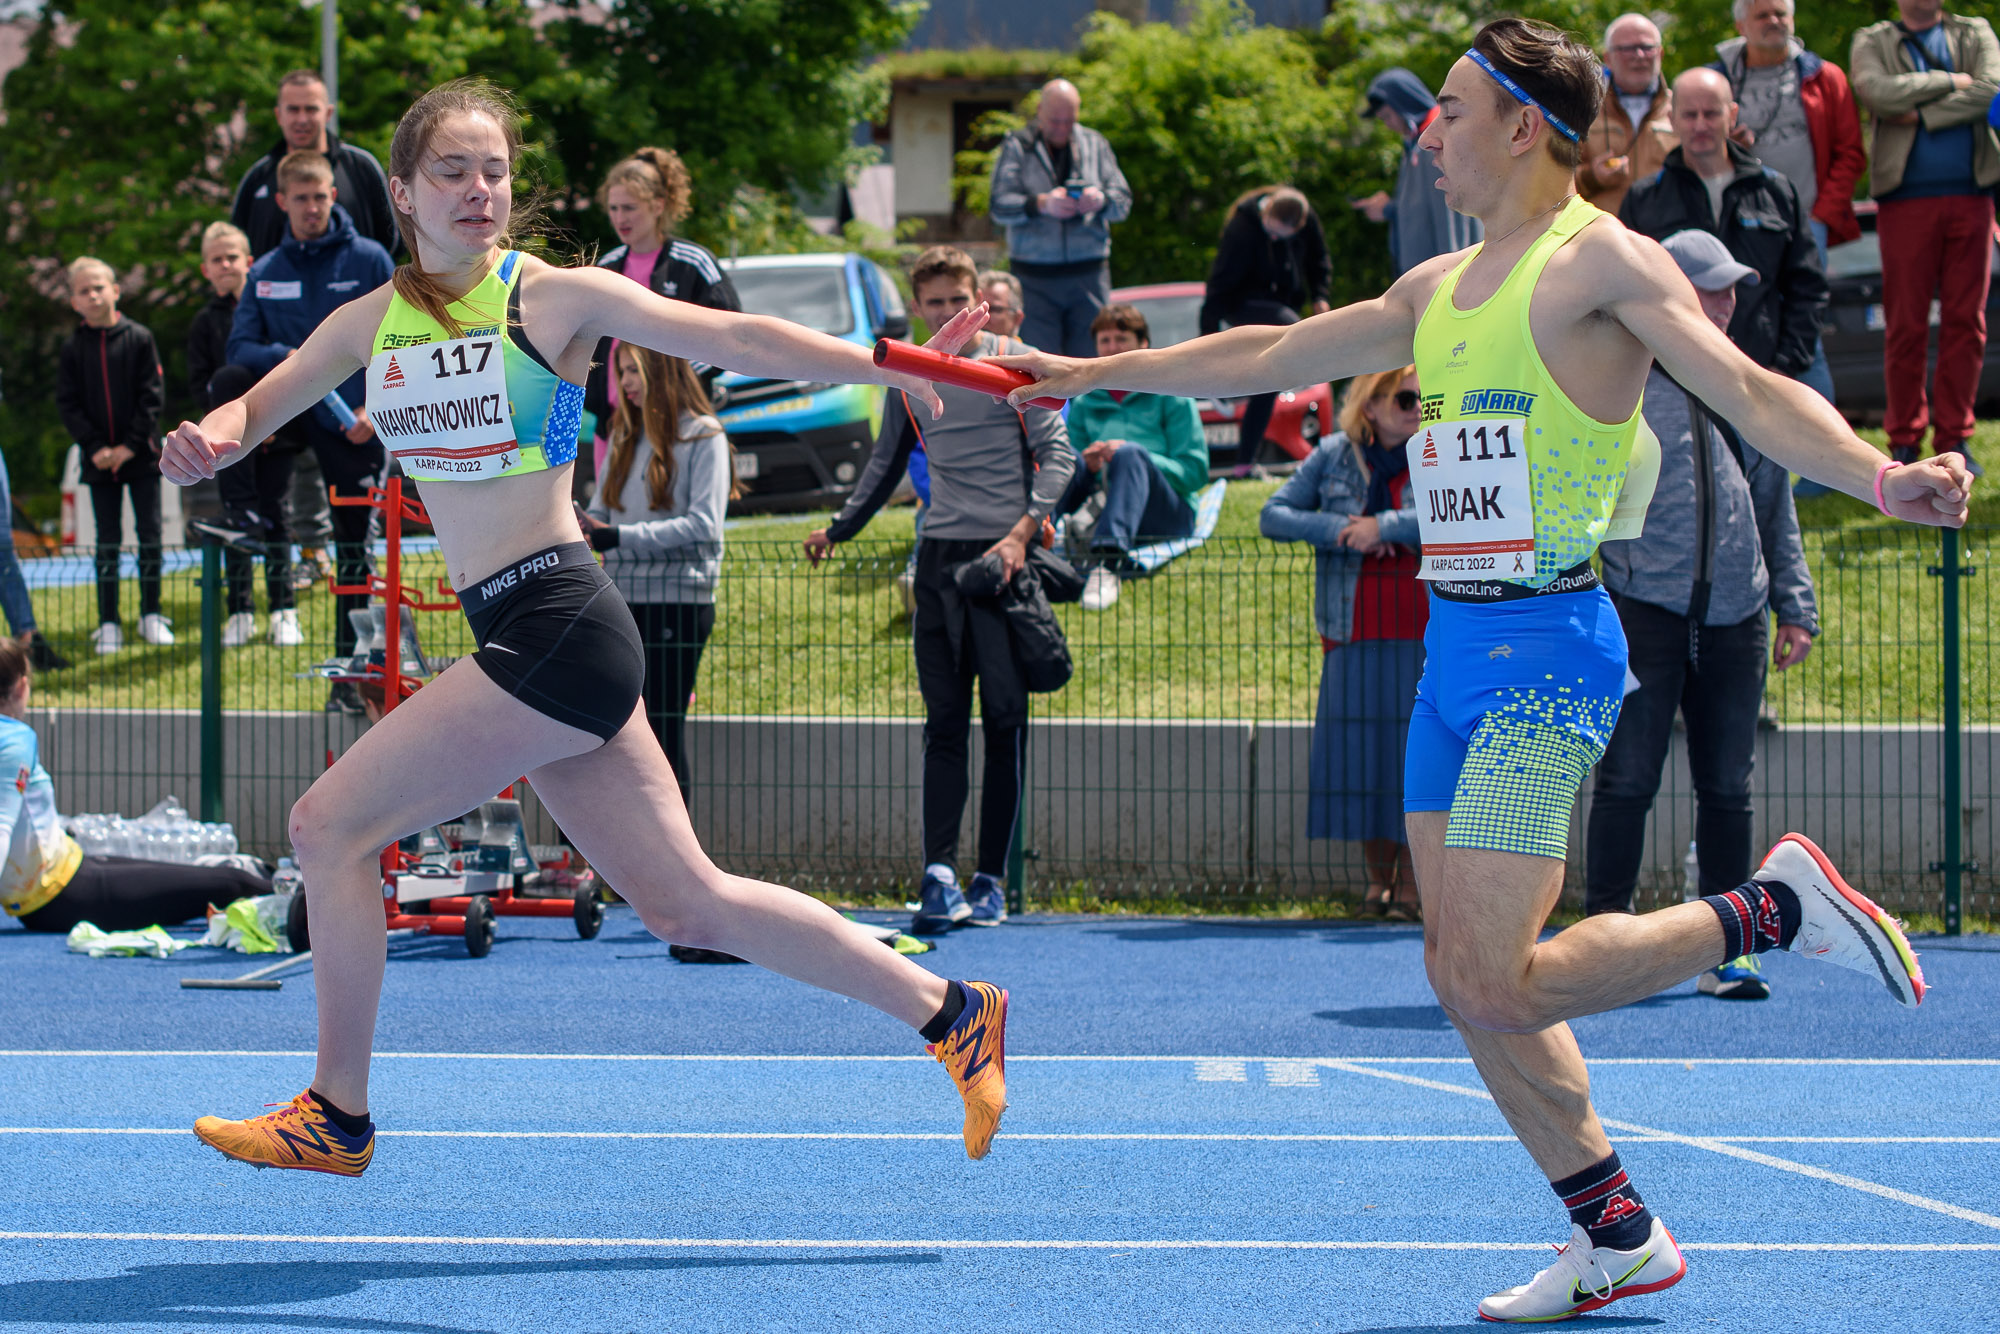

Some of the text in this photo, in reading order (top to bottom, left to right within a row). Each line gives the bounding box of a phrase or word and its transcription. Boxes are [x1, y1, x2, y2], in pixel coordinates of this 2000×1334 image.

[430, 341, 493, 379] 117
[382, 381, 406, 391] KARPACZ
[1460, 389, 1538, 417] SONAROL
[371, 393, 504, 438] WAWRZYNOWICZ
[1456, 424, 1517, 462] 111
[413, 458, 483, 473] KARPACZ 2022
[1428, 485, 1506, 523] JURAK
[480, 551, 560, 601] NIKE PRO
[1431, 556, 1496, 571] KARPACZ 2022
